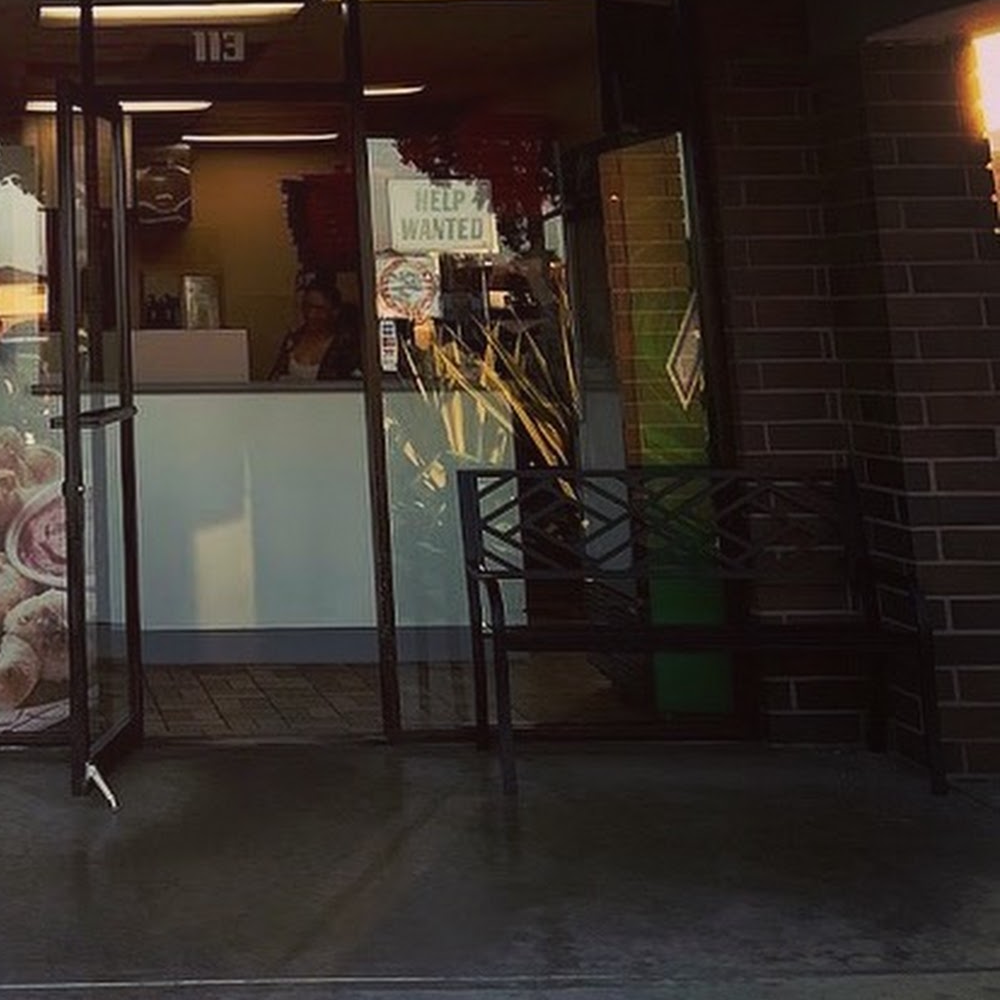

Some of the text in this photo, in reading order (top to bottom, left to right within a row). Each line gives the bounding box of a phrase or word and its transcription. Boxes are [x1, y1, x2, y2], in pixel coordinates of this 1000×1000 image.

[193, 31, 245, 62] 113
[415, 189, 465, 212] HELP
[401, 218, 483, 241] WANTED
